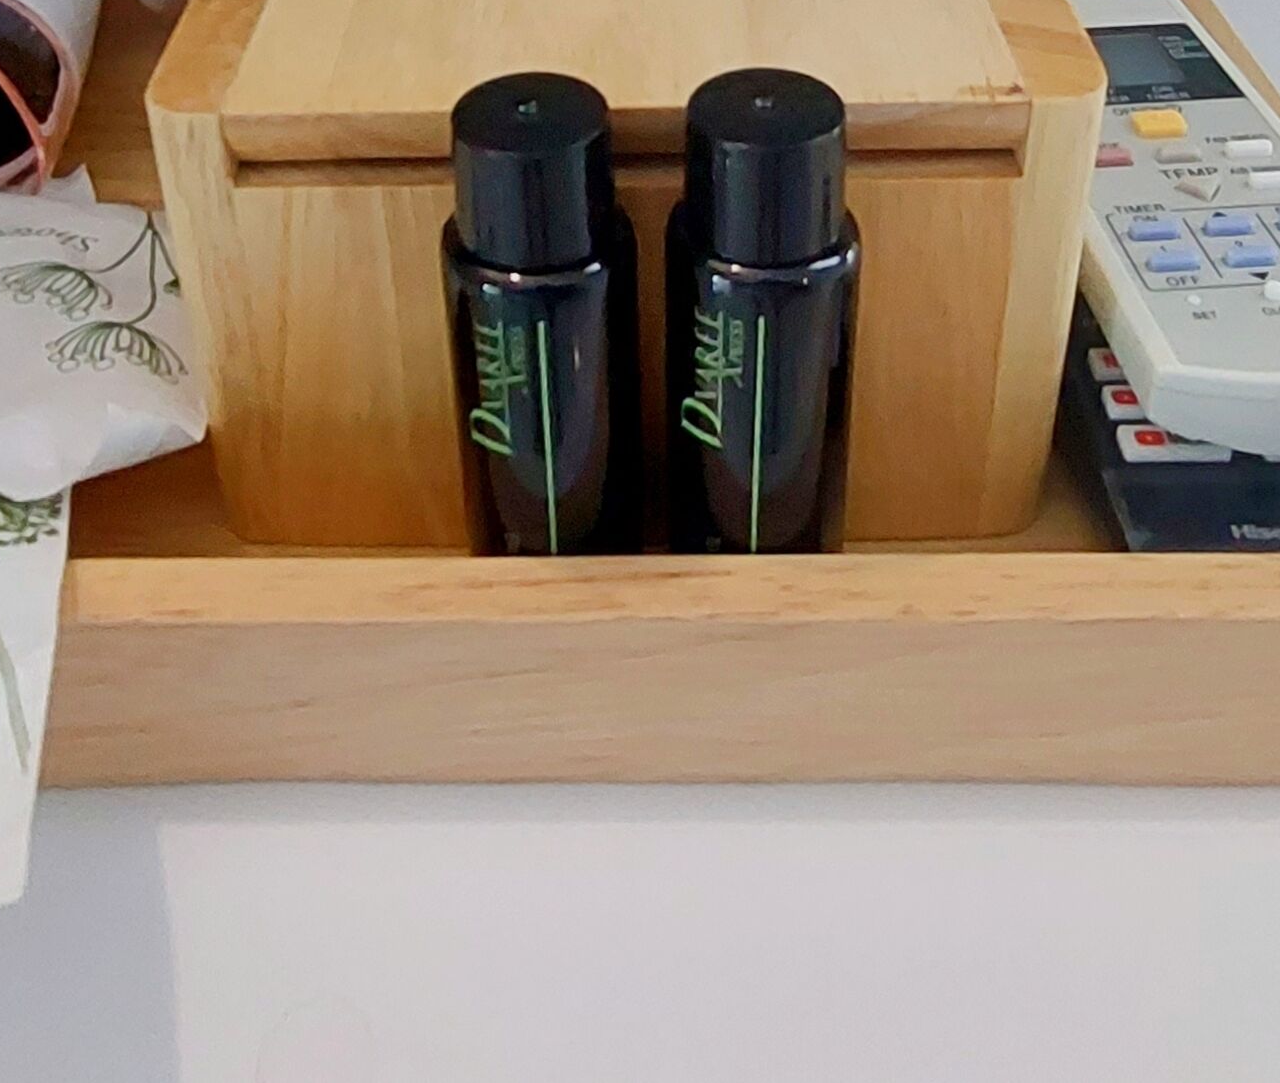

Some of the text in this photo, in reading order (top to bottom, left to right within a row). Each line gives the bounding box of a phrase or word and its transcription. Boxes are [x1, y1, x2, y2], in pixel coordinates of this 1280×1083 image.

[1159, 166, 1218, 181] TEMP
[1114, 204, 1166, 215] TIMER
[1166, 276, 1200, 287] OFF
